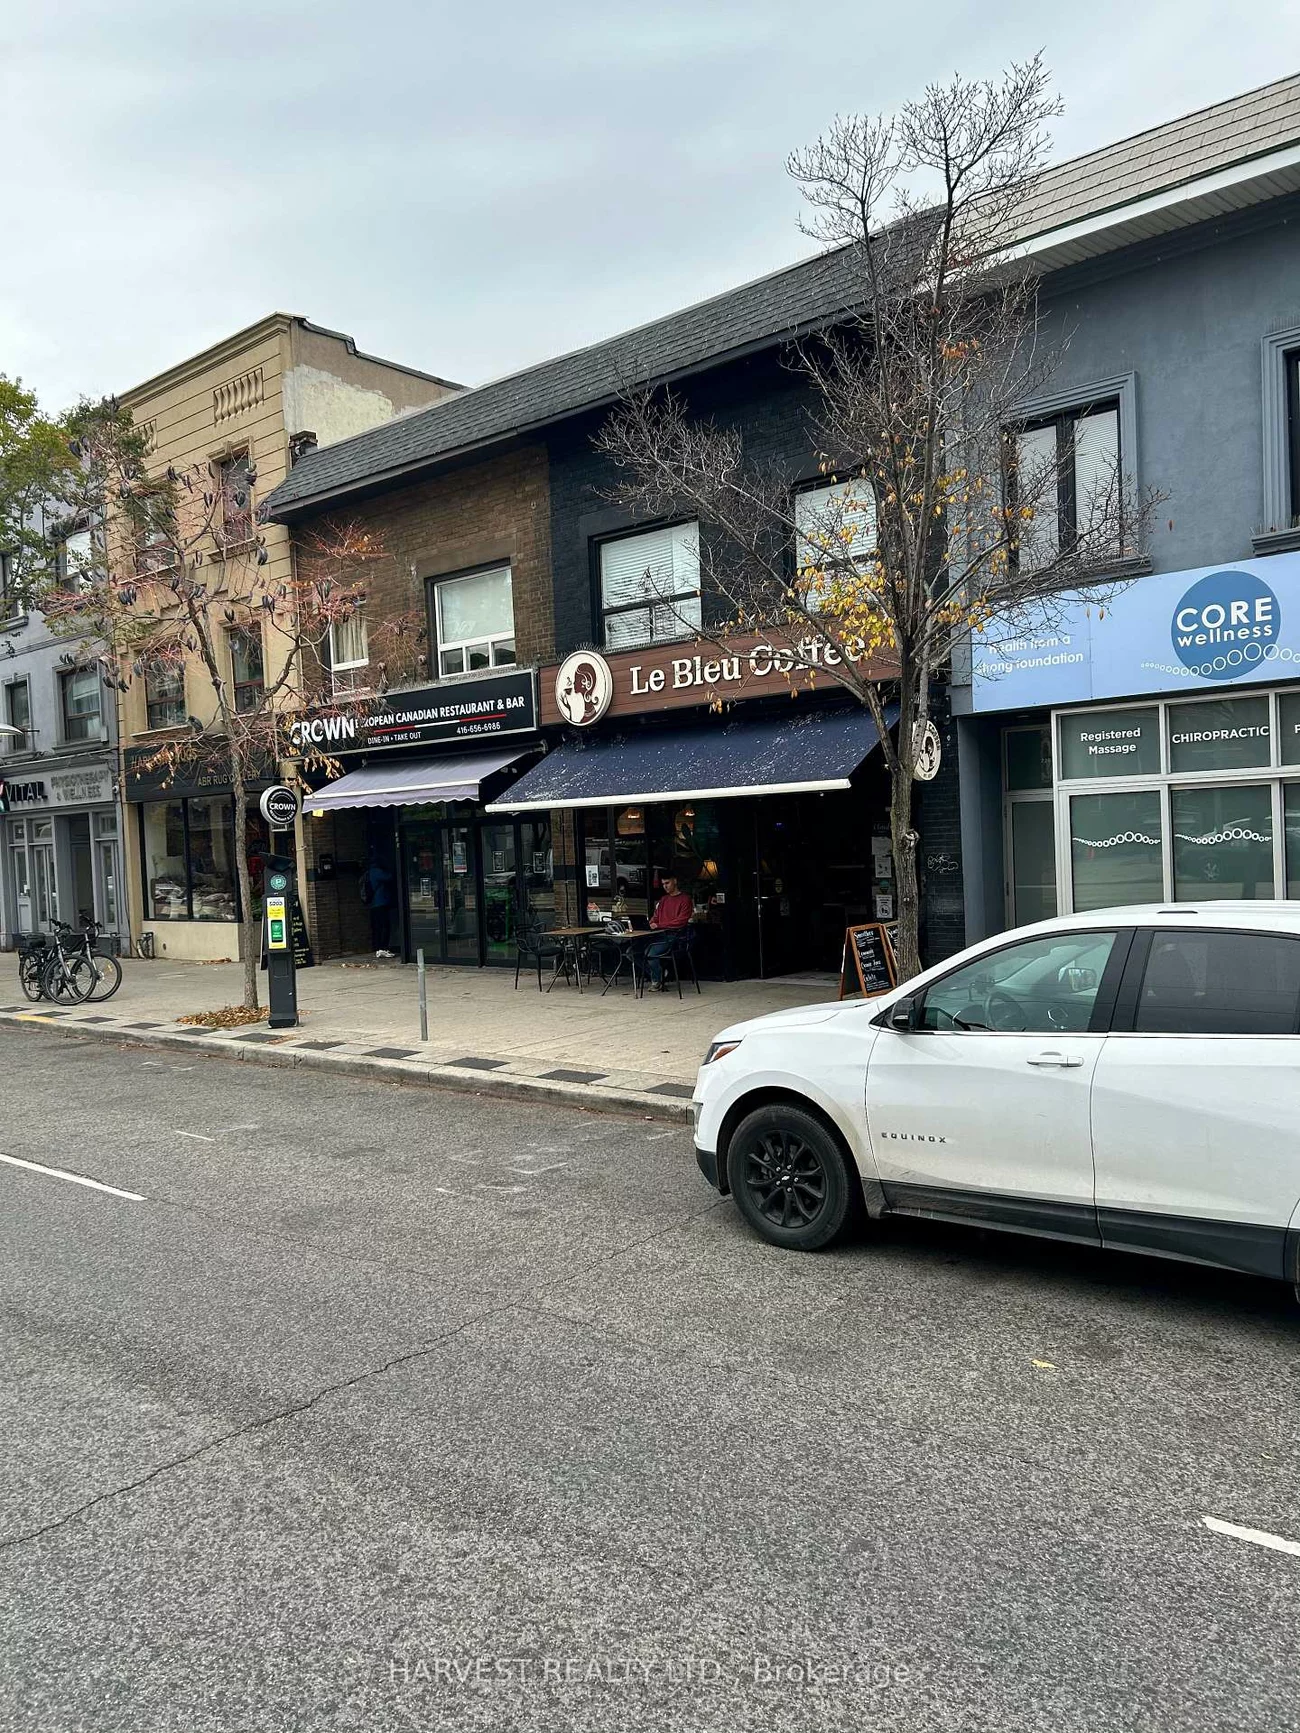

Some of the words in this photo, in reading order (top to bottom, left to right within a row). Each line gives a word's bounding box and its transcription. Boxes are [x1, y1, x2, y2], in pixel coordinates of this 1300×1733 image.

[1177, 597, 1272, 632] CORE
[1062, 635, 1071, 645] a
[1177, 624, 1273, 647] wellness
[630, 666, 665, 695] Le
[672, 656, 741, 688] Bleu
[291, 717, 355, 745] CROWN
[396, 706, 438, 723] CANADIAN
[440, 700, 495, 717] RESTAURANT
[497, 699, 505, 710] &
[506, 696, 526, 709] BAR
[367, 736, 390, 745] DINE-IN
[410, 732, 422, 740] OUT
[1080, 727, 1141, 742] Registered
[1172, 725, 1270, 743] CHIROPRACTIC
[1089, 744, 1137, 755] Massage
[198, 776, 213, 788] ABR
[213, 774, 230, 786] RUG
[5, 782, 44, 802] VITAL
[269, 803, 296, 811] CROWN
[881, 1132, 946, 1144] EQUINOX
